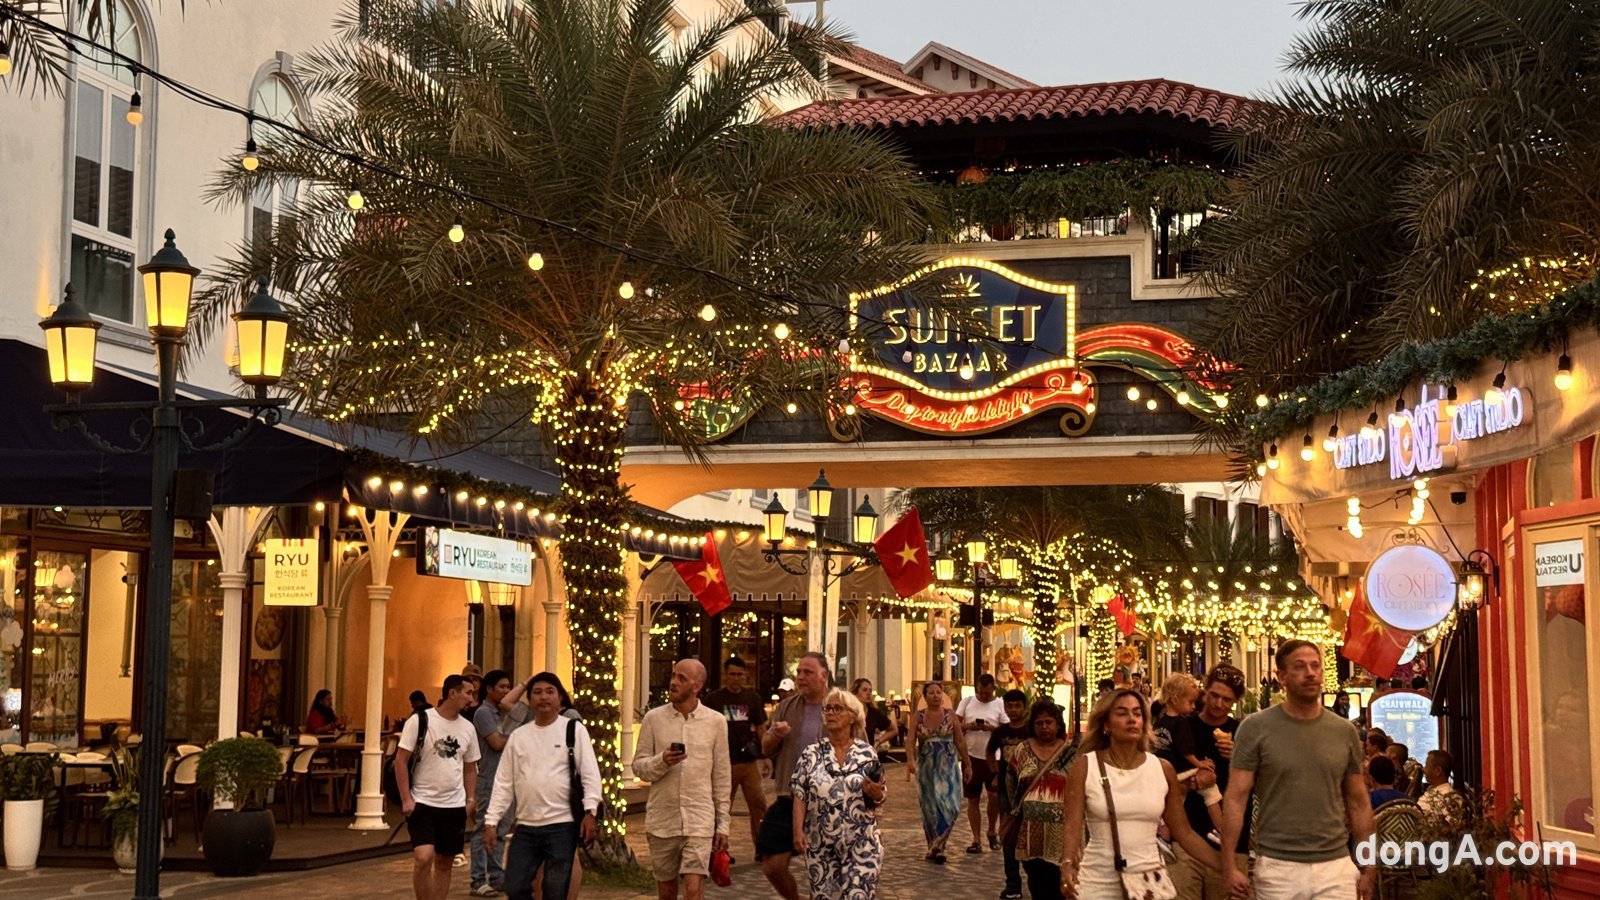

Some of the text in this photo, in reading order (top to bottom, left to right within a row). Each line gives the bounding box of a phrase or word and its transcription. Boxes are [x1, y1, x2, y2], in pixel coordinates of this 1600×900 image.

[914, 352, 1008, 373] BAZAAR
[274, 553, 309, 566] RYU
[453, 545, 477, 568] RYU
[477, 550, 497, 560] KOREAN
[477, 559, 508, 573] RESTAURANT
